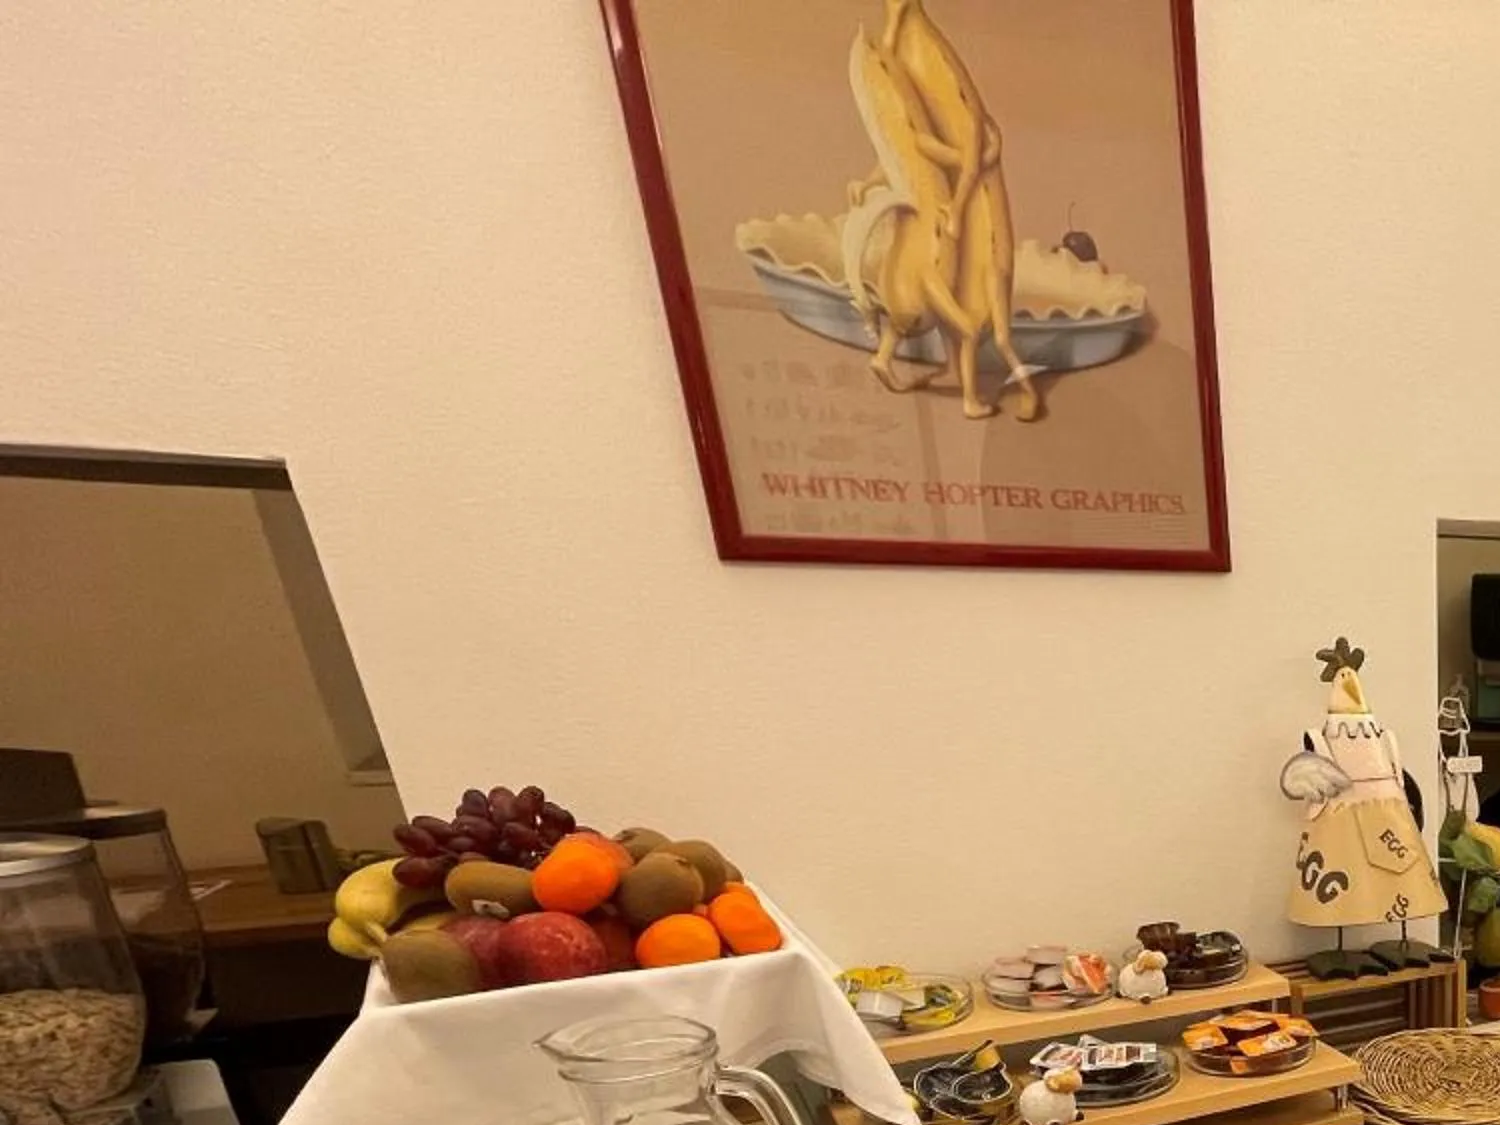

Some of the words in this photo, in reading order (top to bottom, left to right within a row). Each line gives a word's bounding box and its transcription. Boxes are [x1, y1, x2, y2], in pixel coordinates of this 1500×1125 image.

[762, 472, 909, 503] WHITNEY
[1050, 488, 1185, 515] GRAPHICS
[1379, 829, 1408, 859] EGG
